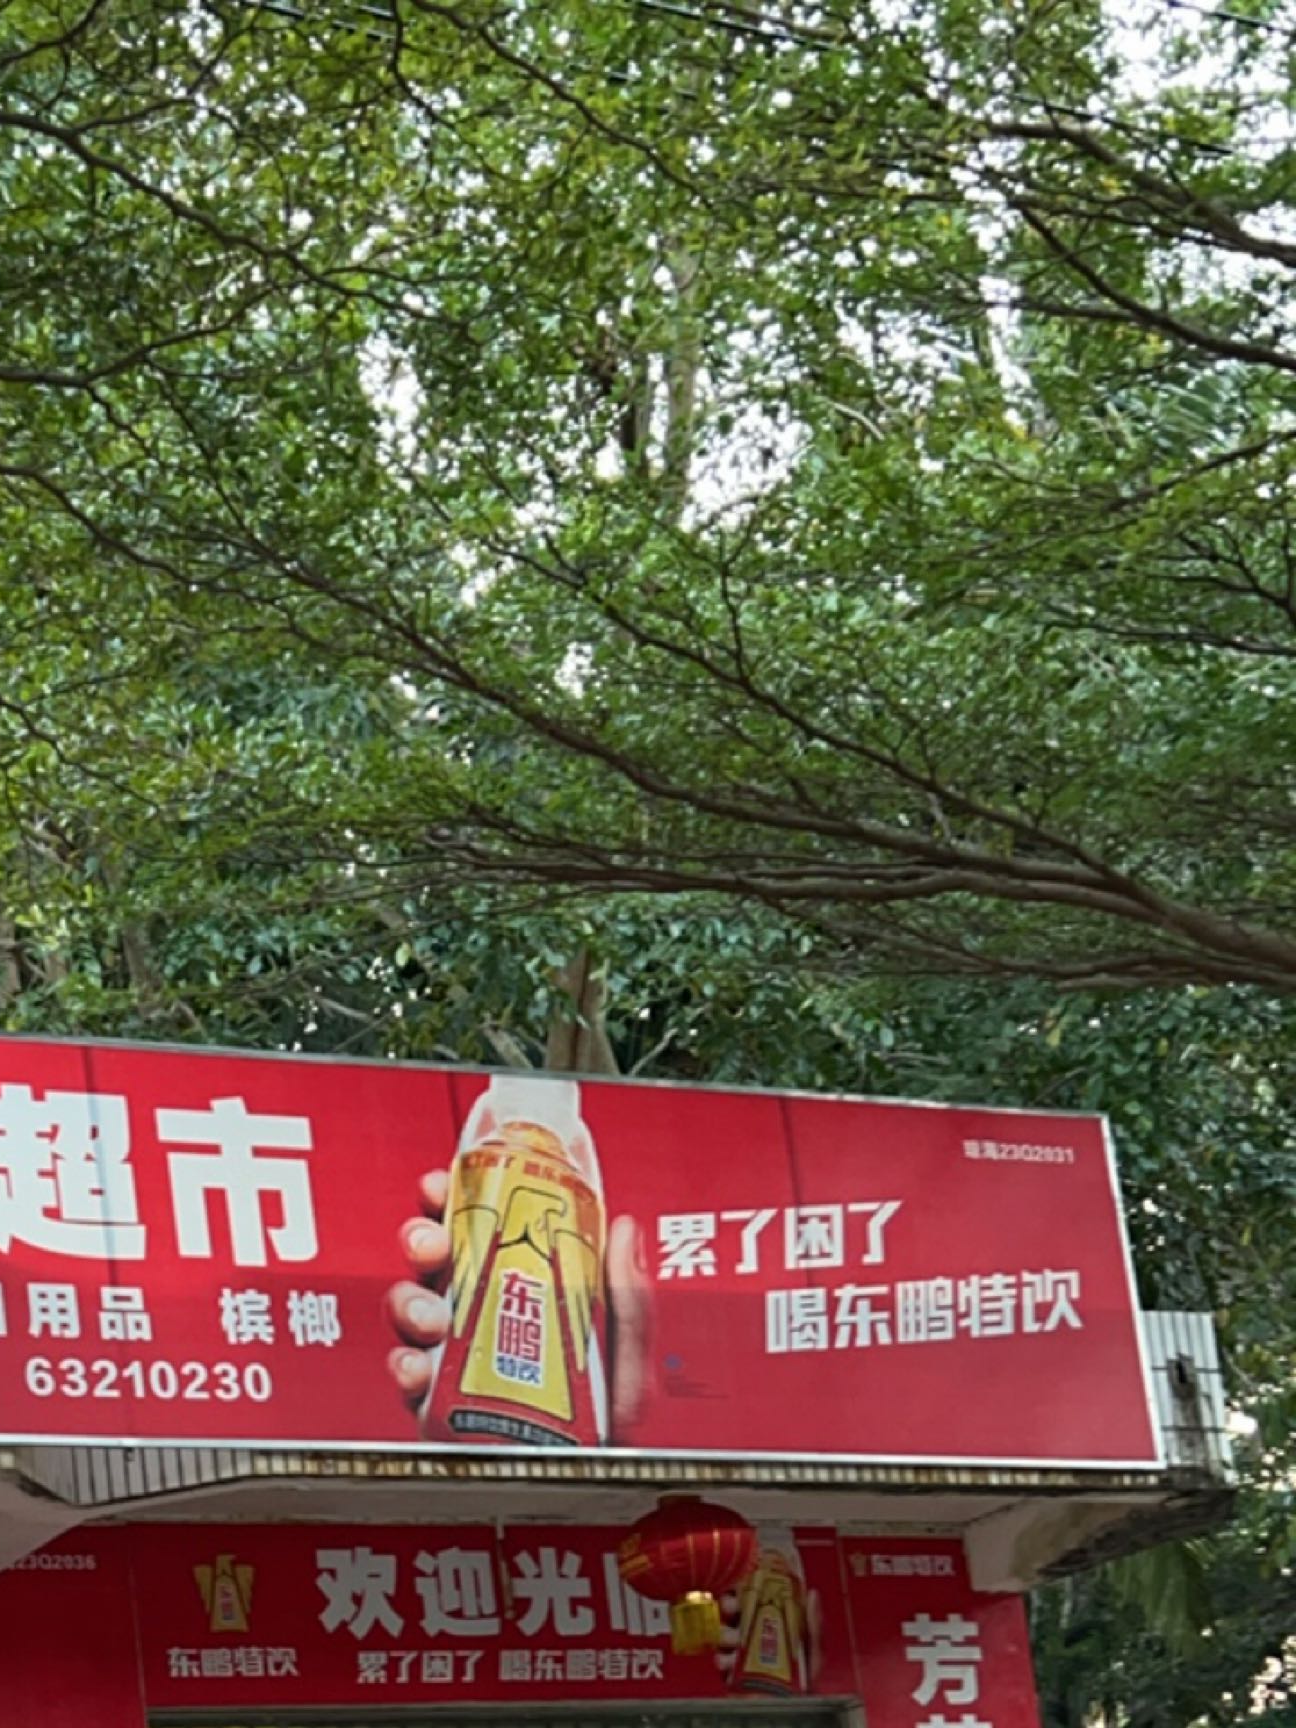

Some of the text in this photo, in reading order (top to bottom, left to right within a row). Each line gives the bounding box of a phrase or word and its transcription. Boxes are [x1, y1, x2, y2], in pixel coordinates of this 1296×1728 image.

[656, 1200, 902, 1280] 累了困了
[765, 1268, 1084, 1353] 喝东鹏特饮
[25, 1355, 273, 1402] 63210230
[166, 1647, 299, 1678] 东鹏特饮
[356, 1650, 484, 1685] 累了困了
